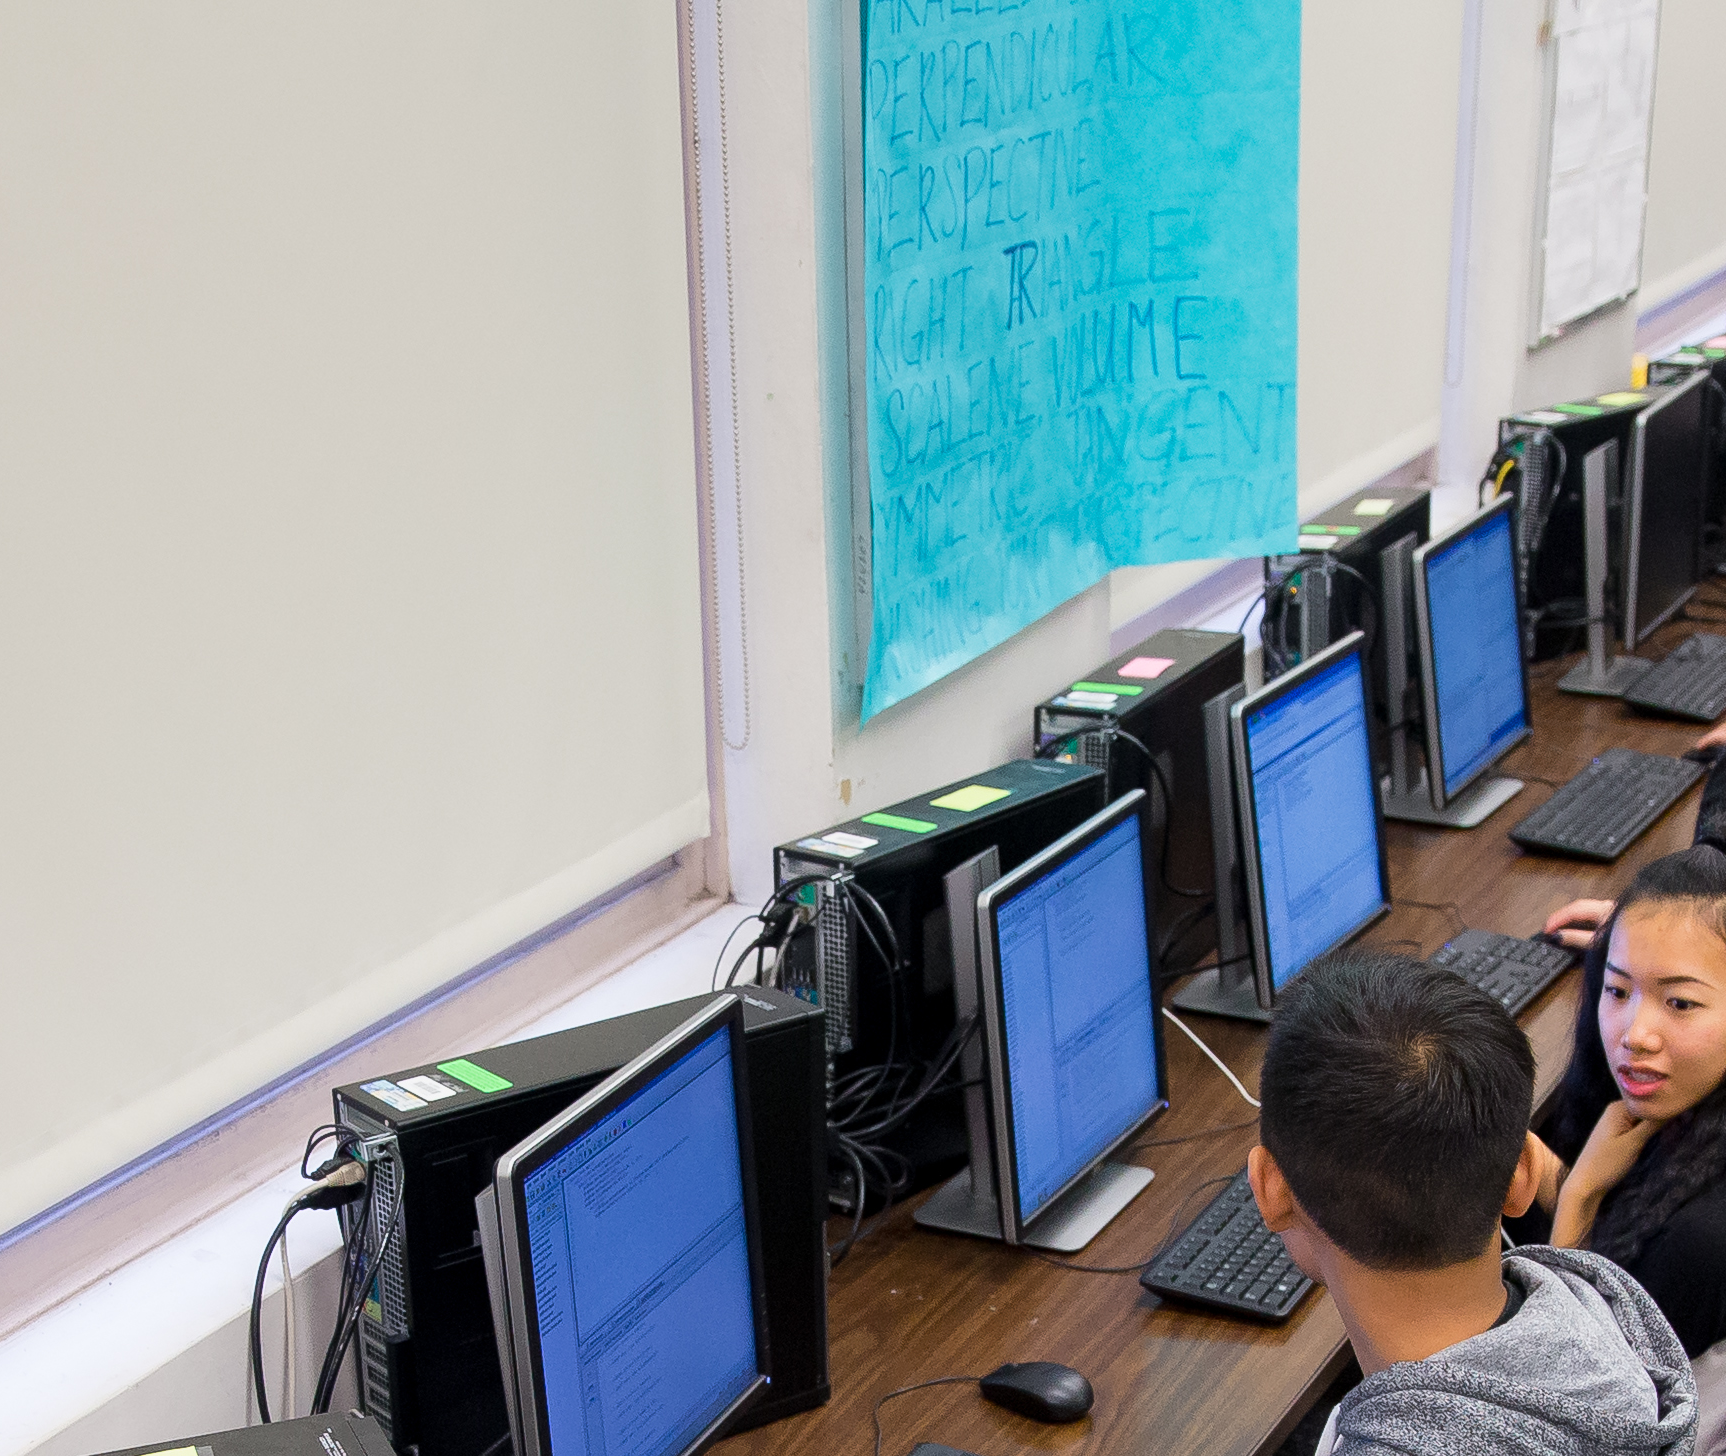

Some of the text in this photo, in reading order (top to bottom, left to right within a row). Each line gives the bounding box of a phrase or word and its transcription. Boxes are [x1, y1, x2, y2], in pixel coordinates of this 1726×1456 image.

[870, 12, 1166, 147] PERPENDICULAR
[871, 117, 1102, 262] PERSPECTIVE
[872, 207, 1199, 383] RIGHT TRIANGLE
